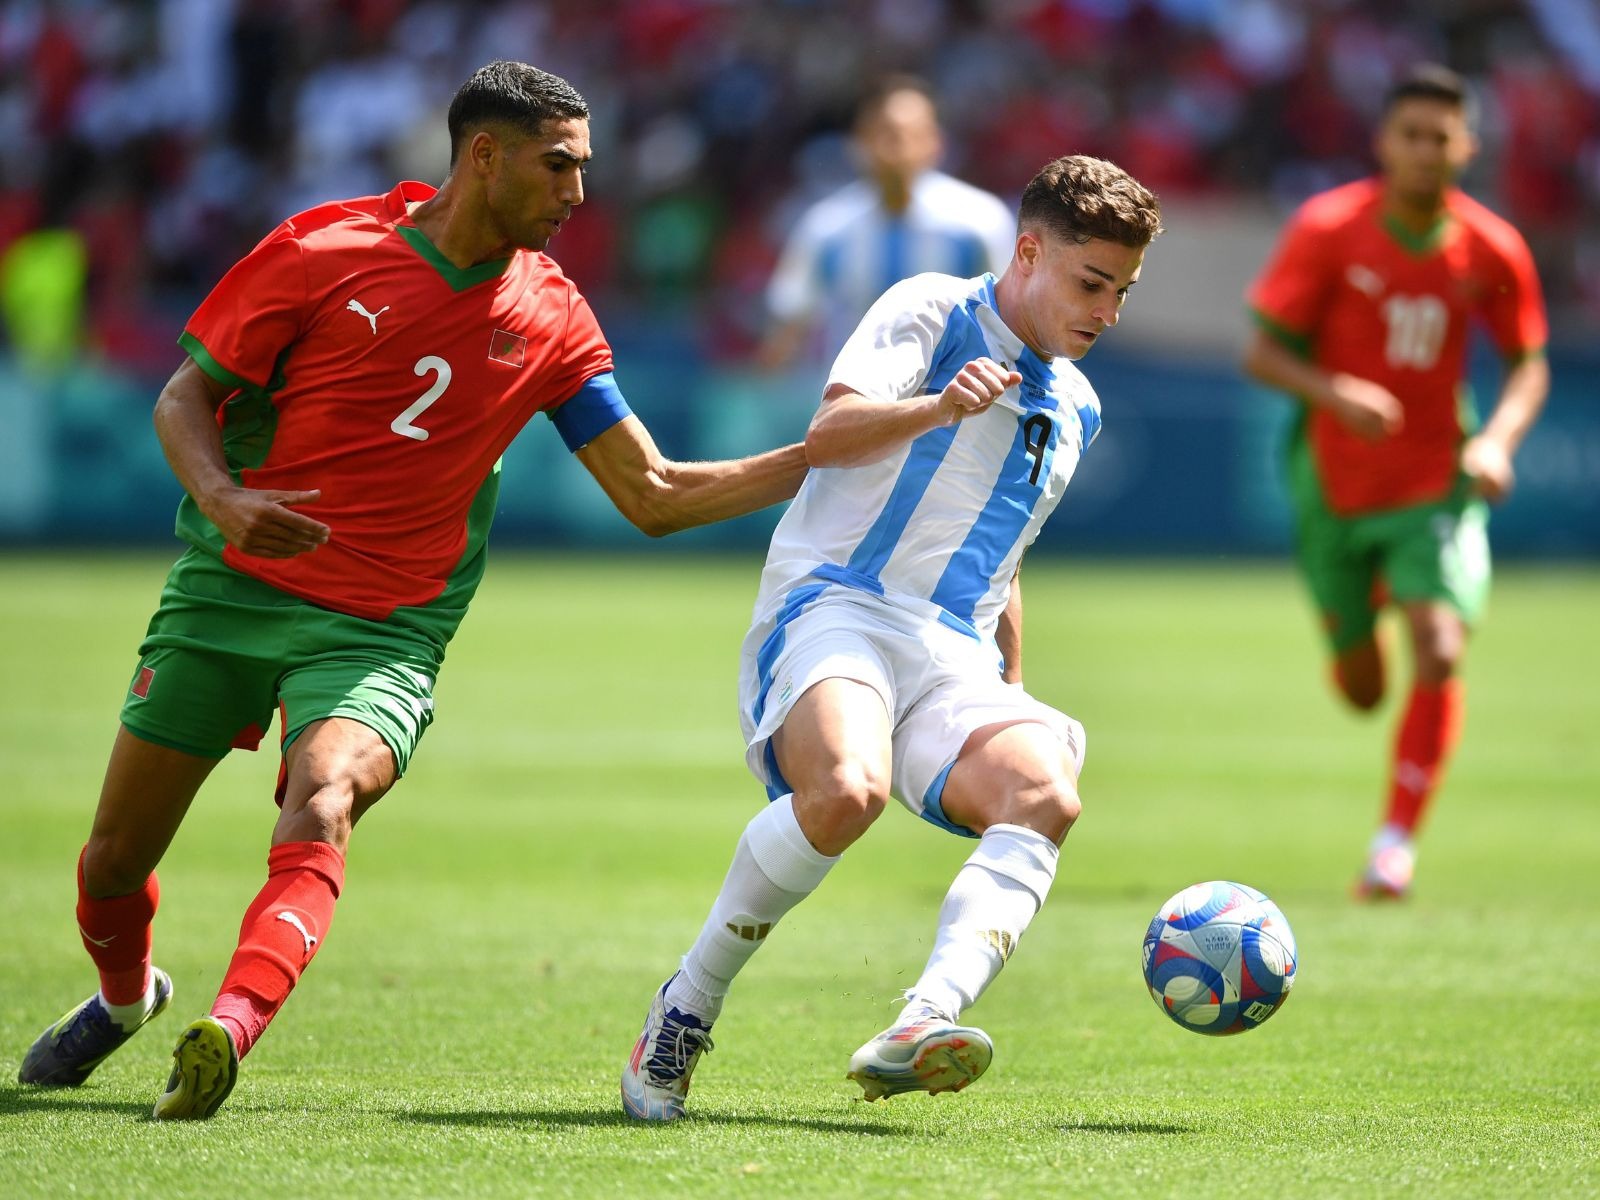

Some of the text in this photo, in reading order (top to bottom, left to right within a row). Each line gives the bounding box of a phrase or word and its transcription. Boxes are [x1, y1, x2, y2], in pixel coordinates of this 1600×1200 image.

[1382, 294, 1447, 370] 10
[391, 355, 452, 441] 2
[1024, 413, 1052, 487] 9
